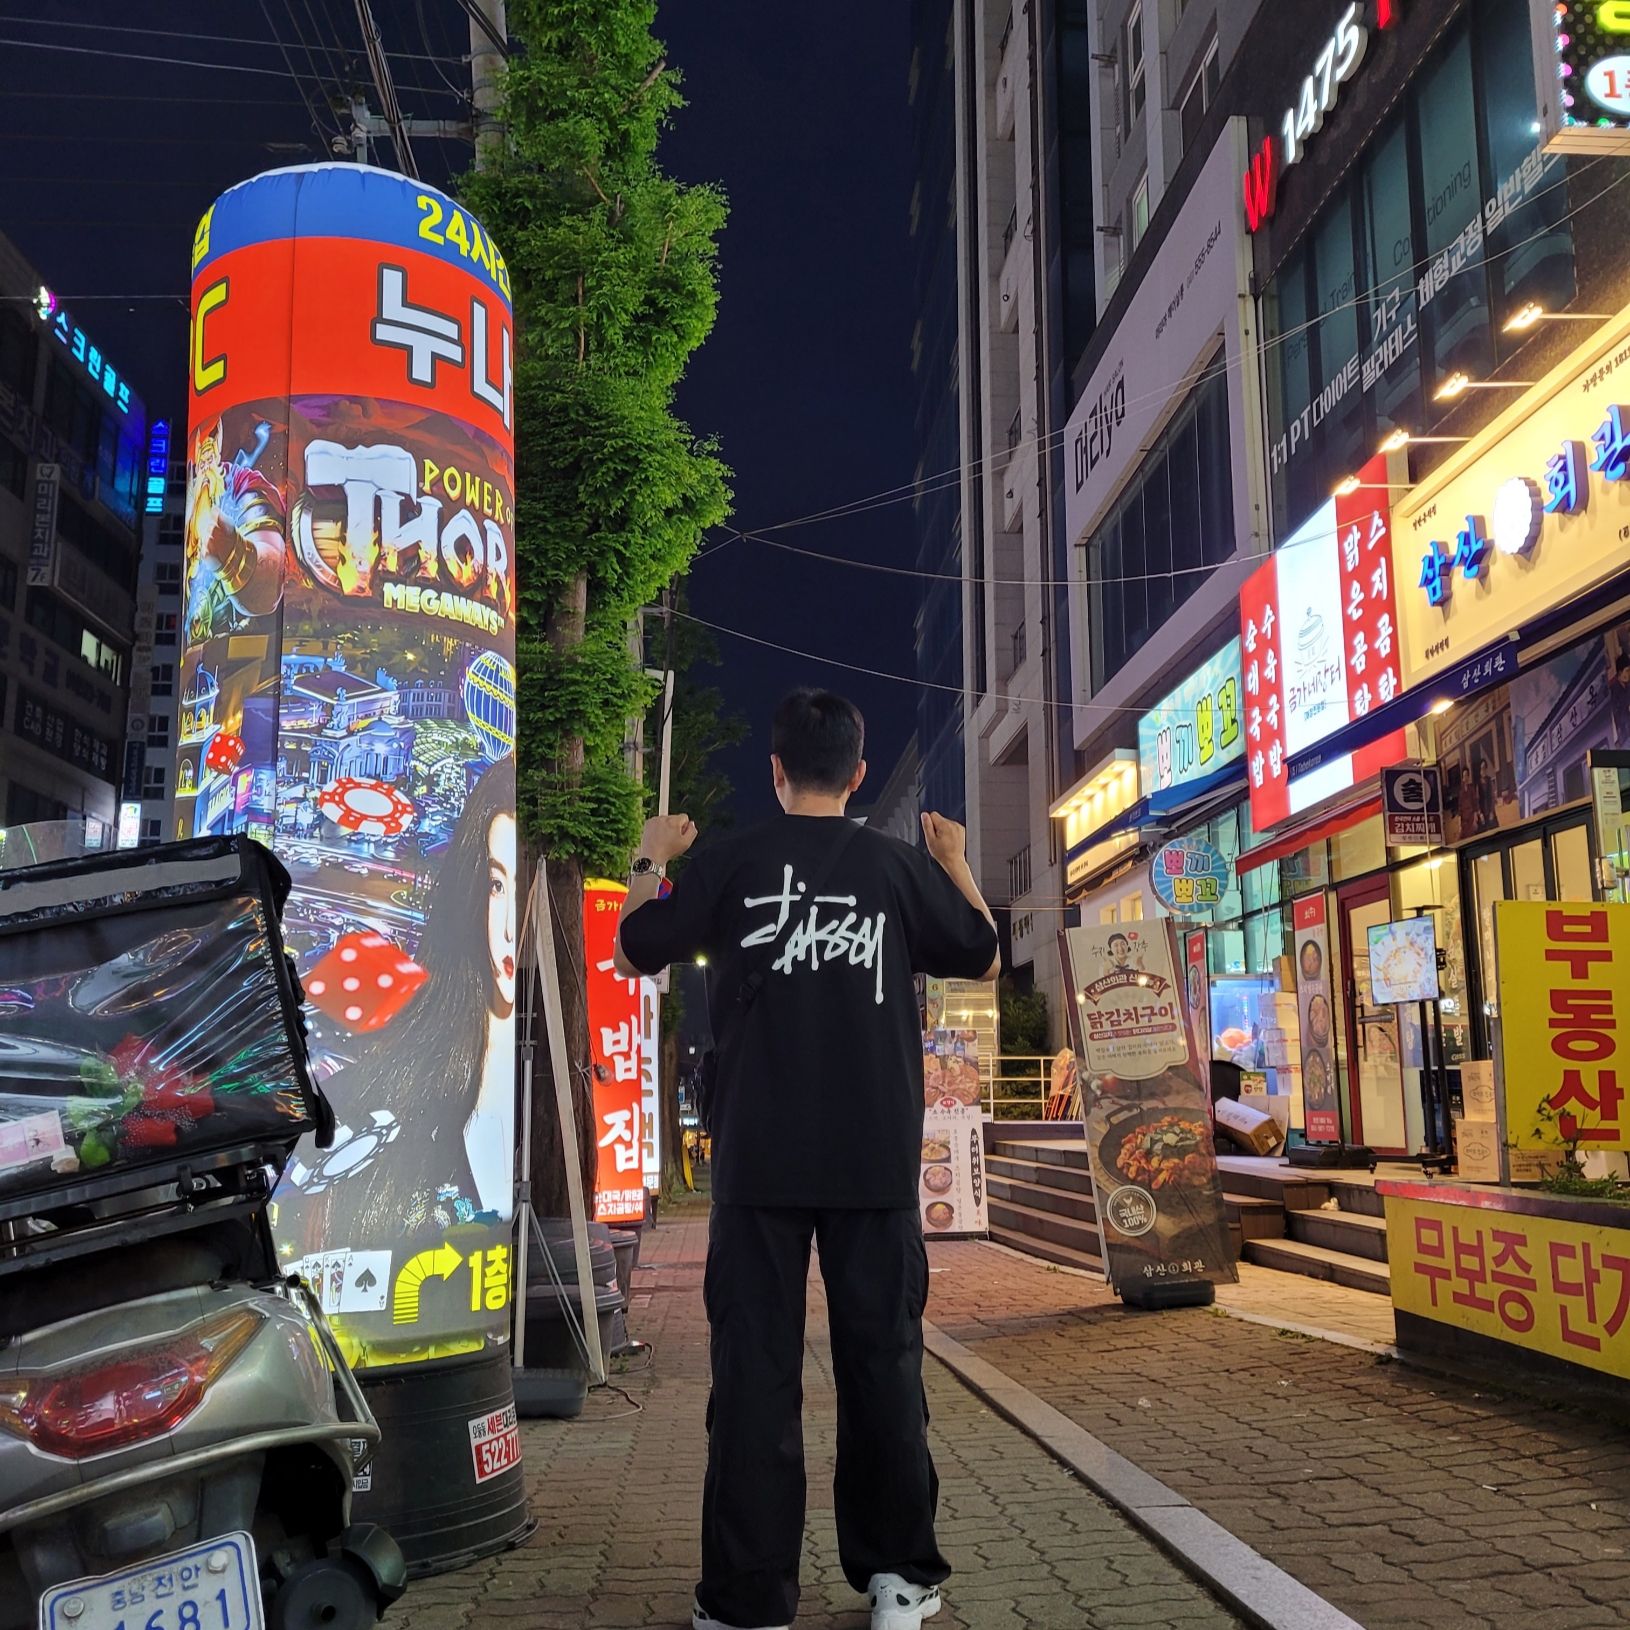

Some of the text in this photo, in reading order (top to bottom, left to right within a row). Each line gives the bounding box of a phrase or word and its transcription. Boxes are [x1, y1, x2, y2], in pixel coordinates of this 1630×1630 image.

[1244, 1, 1360, 232] W 1475
[1417, 212, 1484, 311] 체형교정
[371, 262, 512, 432] 누나
[1372, 286, 1401, 344] 기구
[54, 310, 131, 414] 스크린골프
[1362, 312, 1419, 394] 필라테스
[1271, 352, 1361, 475] 1:1 PT 다이어트
[145, 419, 169, 515] 스크린골프
[422, 459, 505, 525] POWER
[305, 439, 509, 606] THOR
[1417, 404, 1630, 606] 삼산 회관
[31, 568, 46, 583] 7F
[1367, 510, 1398, 703] 스지곰탕
[1342, 525, 1372, 717] 맑은곰탕
[1245, 619, 1265, 789] 순대국밥
[1261, 603, 1283, 779] 수육국밥
[1288, 655, 1343, 713] 금가네장터
[1460, 651, 1506, 690] 삼산회관
[23, 717, 42, 736] CAD
[1394, 823, 1436, 833] 김치찌개
[1163, 849, 1211, 875] 뽀끼
[595, 899, 622, 912] 금가
[1087, 1002, 1176, 1029] 닭김치구이
[1095, 973, 1127, 992] 삼산회관
[1544, 909, 1625, 1143] 부동산
[1119, 1205, 1145, 1217] 국내산
[1123, 1215, 1147, 1228] 100%
[469, 1245, 507, 1312] 1층
[1143, 1259, 1206, 1277] 삼산 회관
[1414, 1217, 1538, 1334] 무보증
[111, 1564, 201, 1612] 충남 천안
